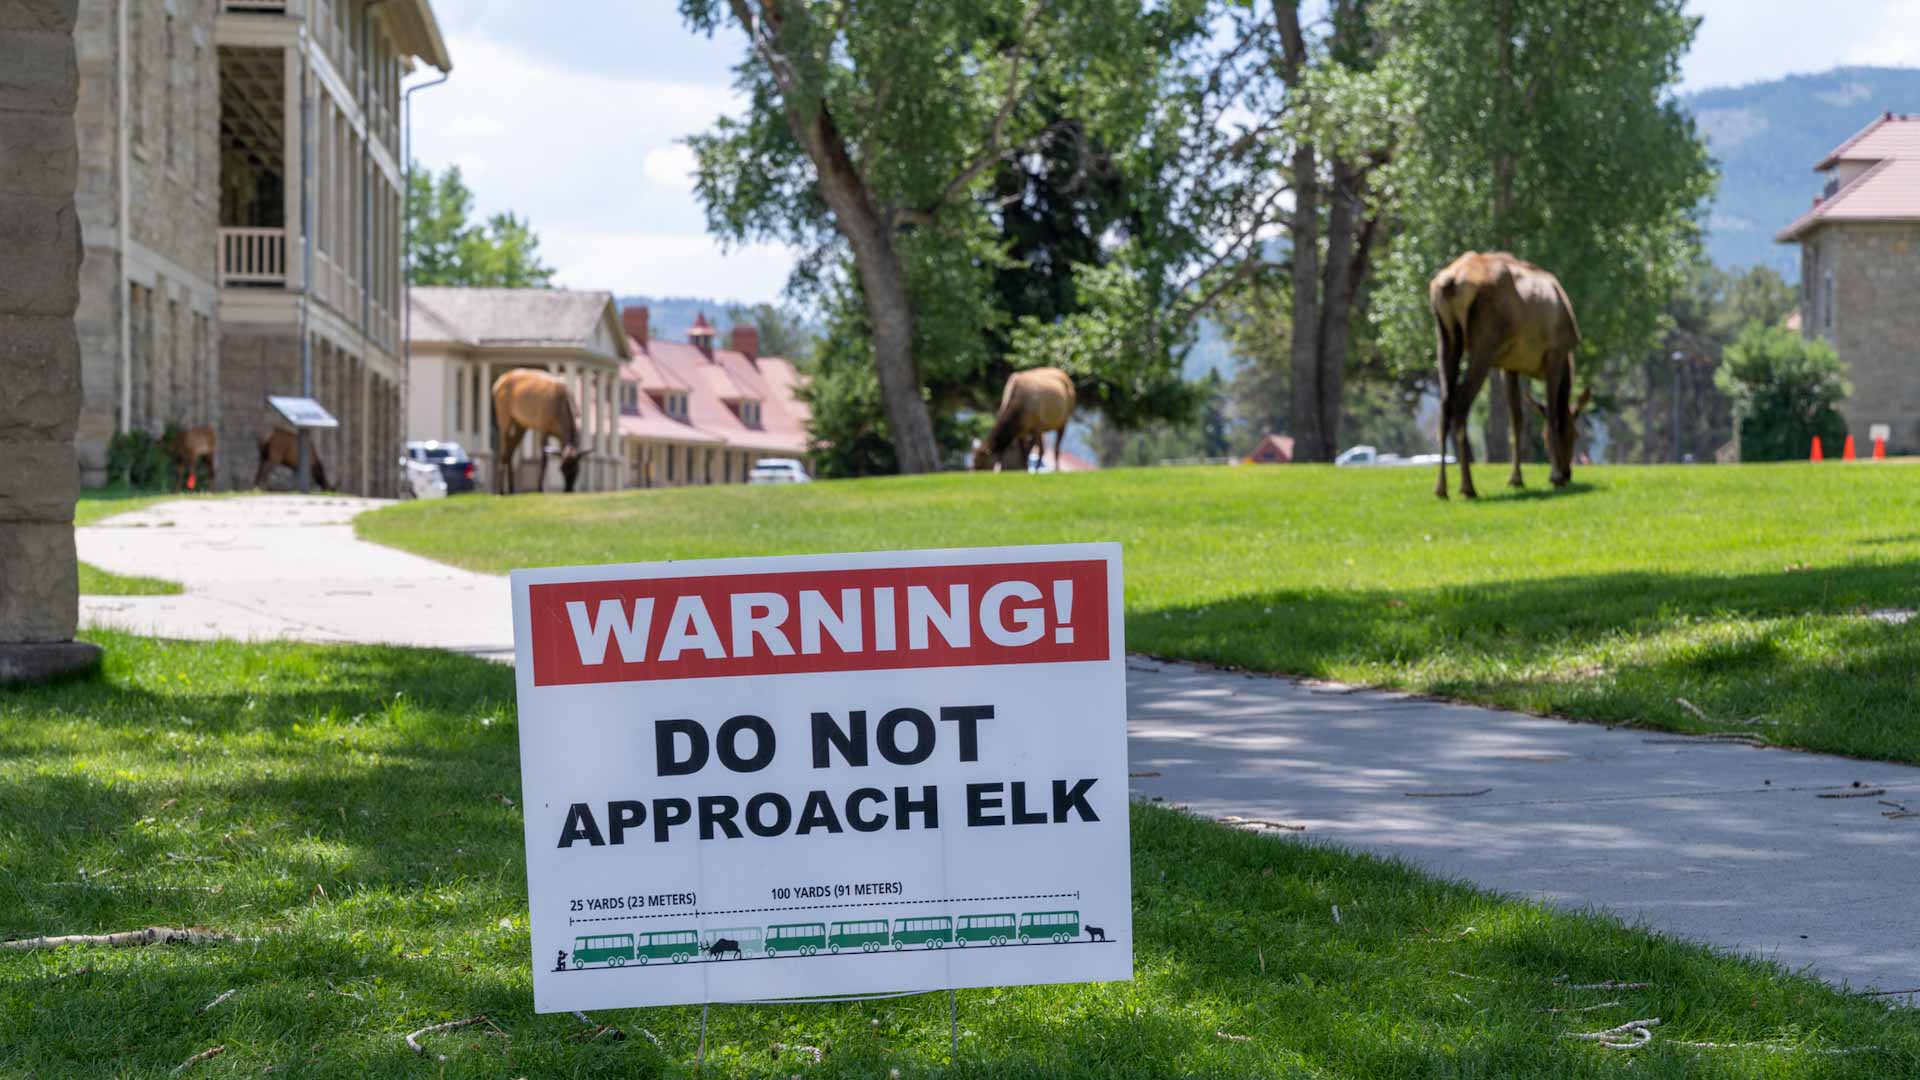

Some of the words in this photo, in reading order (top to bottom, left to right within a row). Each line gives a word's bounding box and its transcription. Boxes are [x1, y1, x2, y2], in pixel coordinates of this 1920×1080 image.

[566, 579, 1075, 665] WARNING!
[654, 714, 777, 777] DO
[810, 704, 995, 770] NOT
[556, 784, 939, 849] APPROACH
[965, 777, 1101, 828] ELK
[570, 899, 584, 912] 25
[586, 896, 625, 911] YARDS
[627, 895, 645, 910] (23
[648, 892, 697, 907] METERS)
[770, 887, 791, 900] 100
[793, 884, 832, 899] YARDS
[833, 883, 851, 899] (91
[854, 881, 903, 896] METERS)
